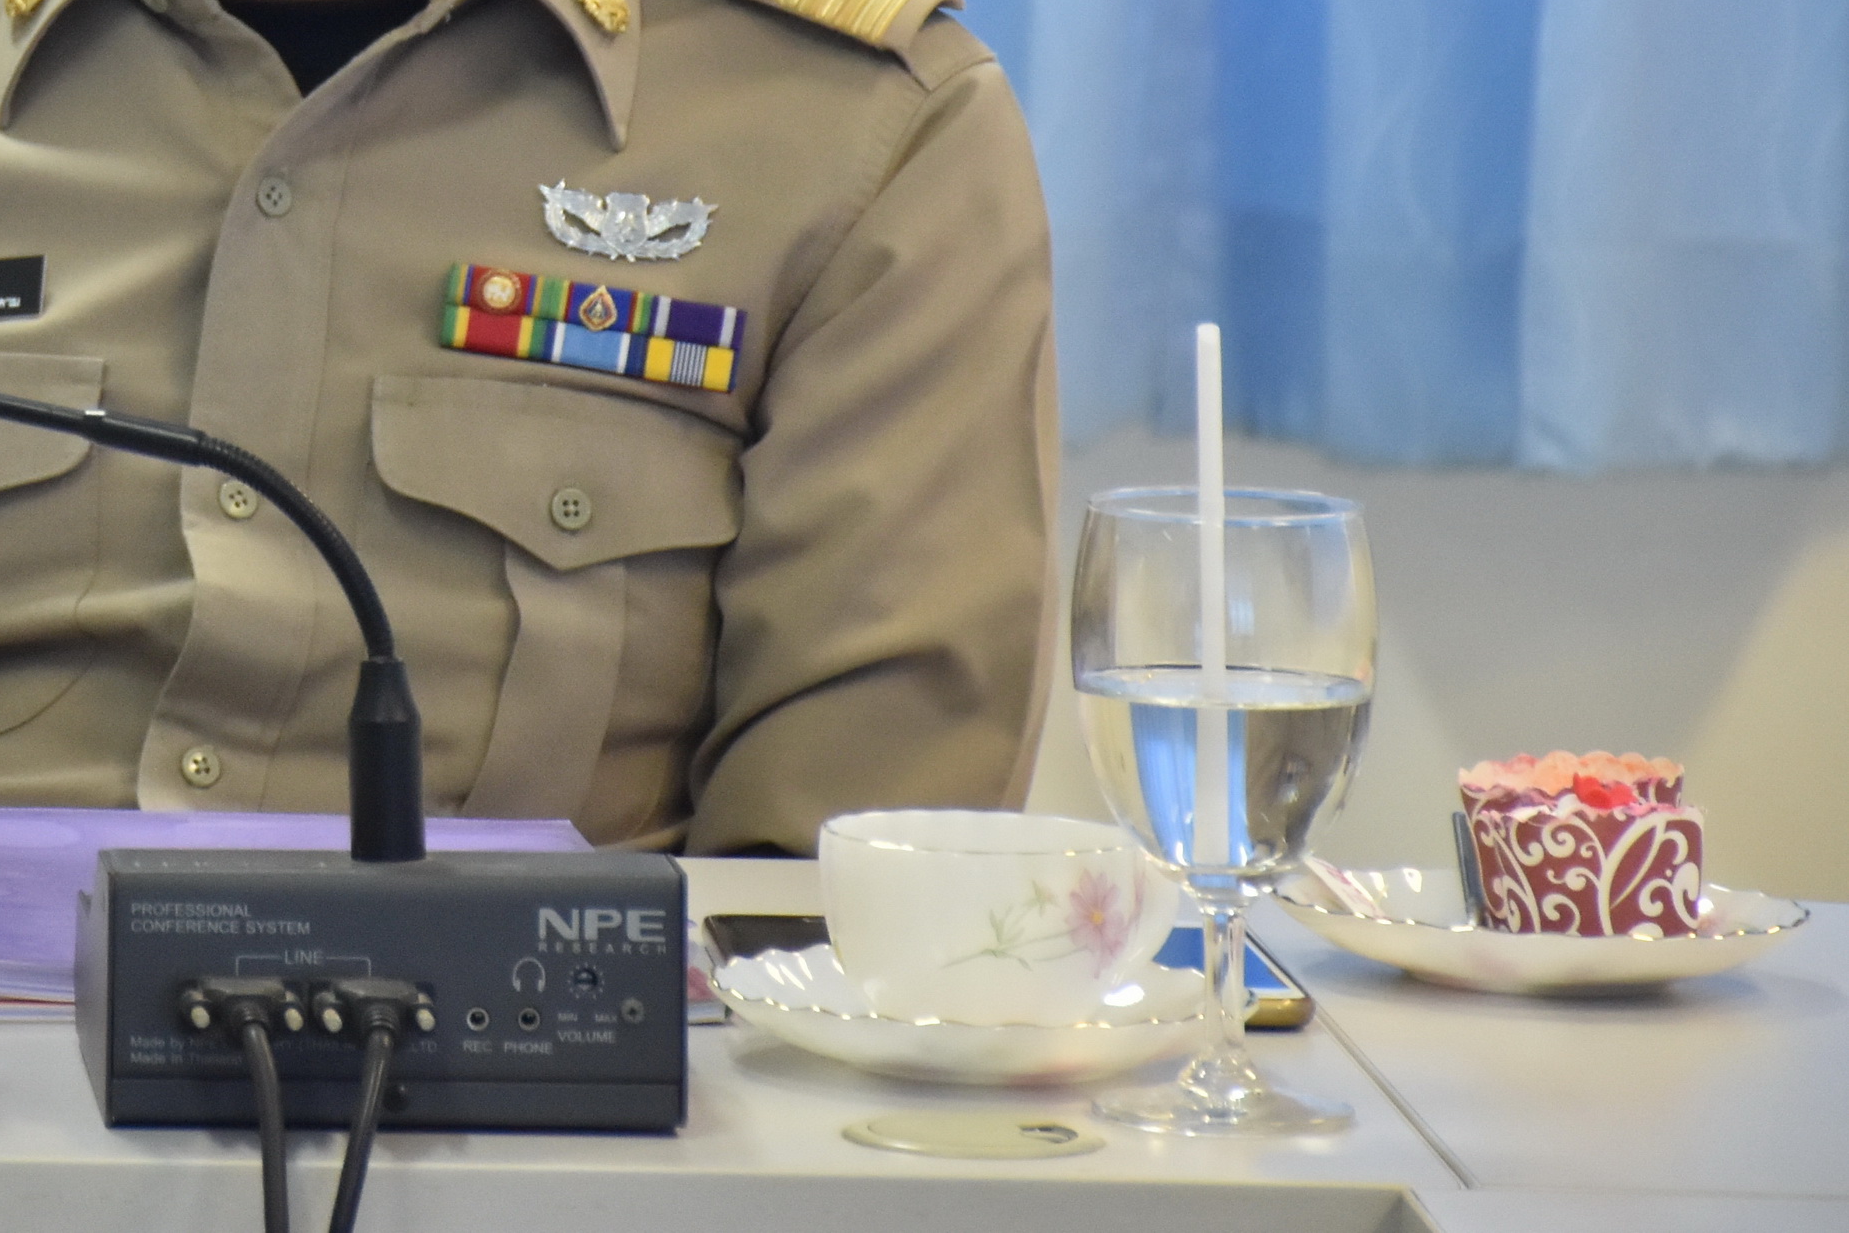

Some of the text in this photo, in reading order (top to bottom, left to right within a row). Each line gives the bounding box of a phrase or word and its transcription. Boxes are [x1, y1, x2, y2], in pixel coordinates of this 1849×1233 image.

[130, 902, 252, 918] PROFESSIONAL
[130, 919, 311, 935] CONFERENCE SYSTEM
[538, 907, 666, 942] NPE
[538, 941, 666, 955] RESEARCH
[283, 949, 323, 965] LINE
[557, 1012, 578, 1022] MIN
[594, 1013, 617, 1023] MAX
[557, 1030, 615, 1043] VOLUME
[462, 1039, 492, 1053] REC
[503, 1041, 552, 1055] PHONE
